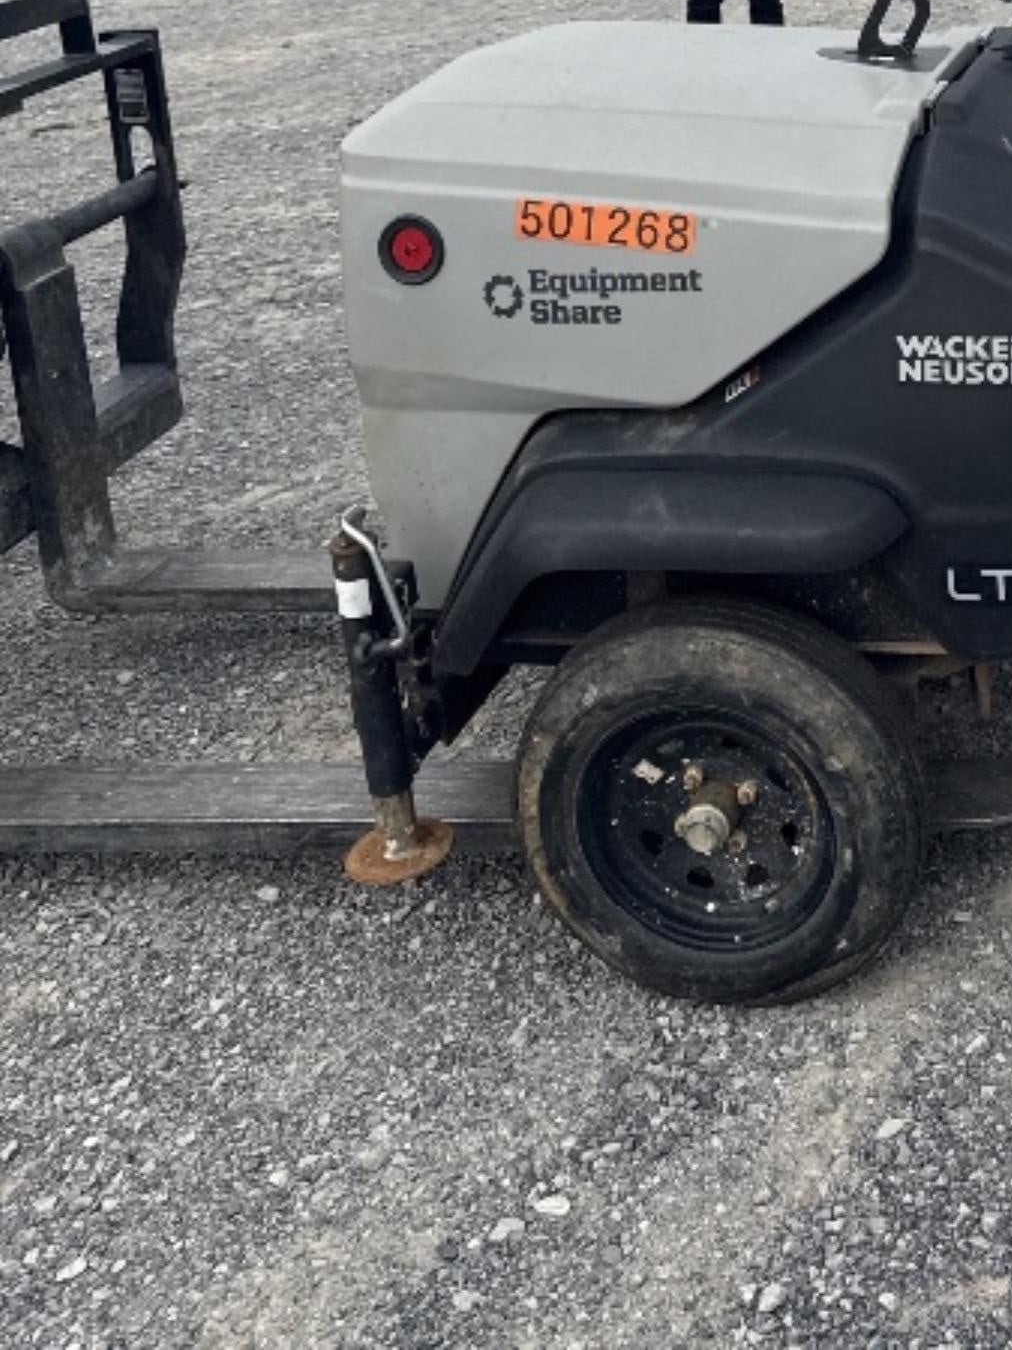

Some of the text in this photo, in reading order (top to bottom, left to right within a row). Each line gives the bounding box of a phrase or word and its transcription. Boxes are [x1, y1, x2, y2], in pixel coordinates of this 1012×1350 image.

[519, 199, 690, 253] 501268
[527, 266, 703, 299] Equipment
[529, 299, 622, 326] Share
